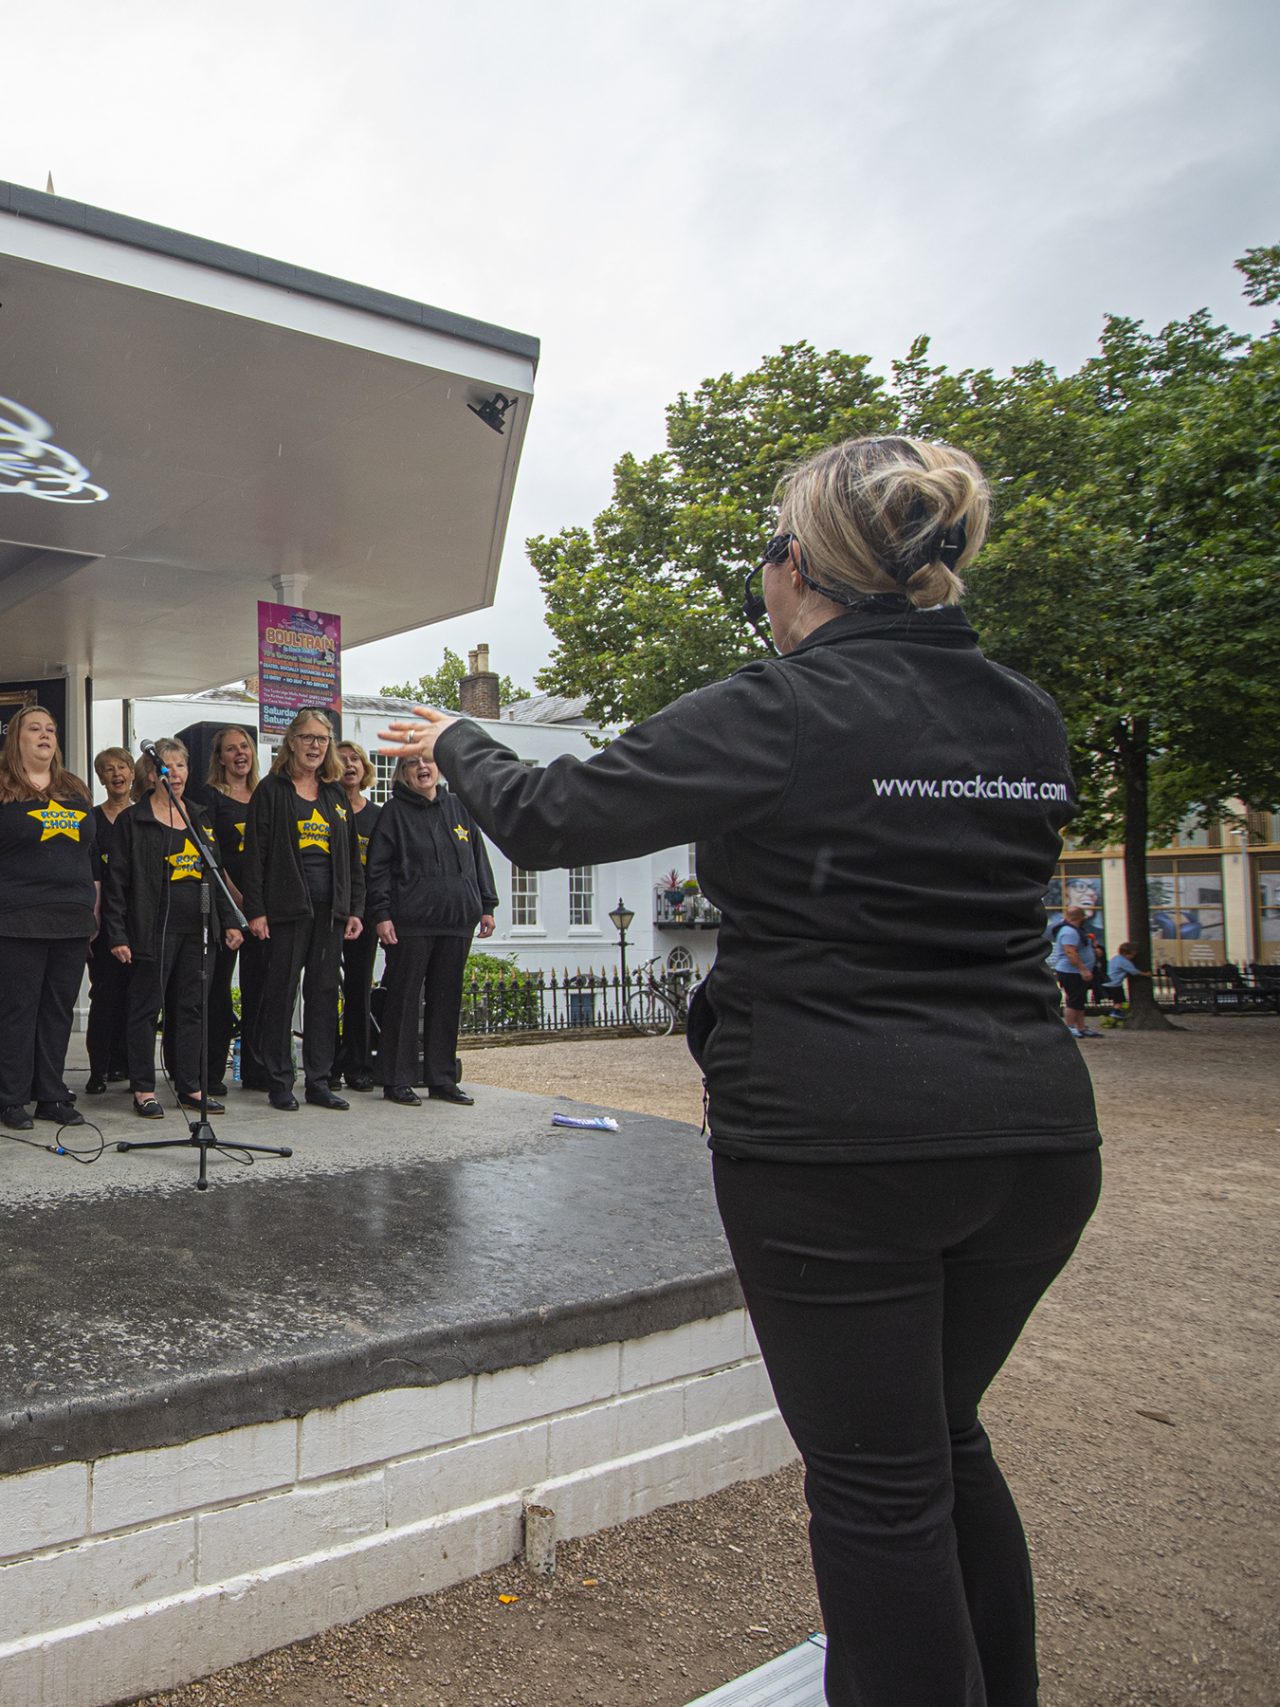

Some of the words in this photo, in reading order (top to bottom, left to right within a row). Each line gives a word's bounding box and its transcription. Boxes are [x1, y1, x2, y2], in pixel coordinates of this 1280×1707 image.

[265, 627, 336, 653] SOULTRAIN
[263, 714, 293, 727] Saturd
[872, 775, 1069, 801] www.rockchoir.com
[41, 810, 78, 820] ROCK
[41, 819, 81, 830] CHOIR
